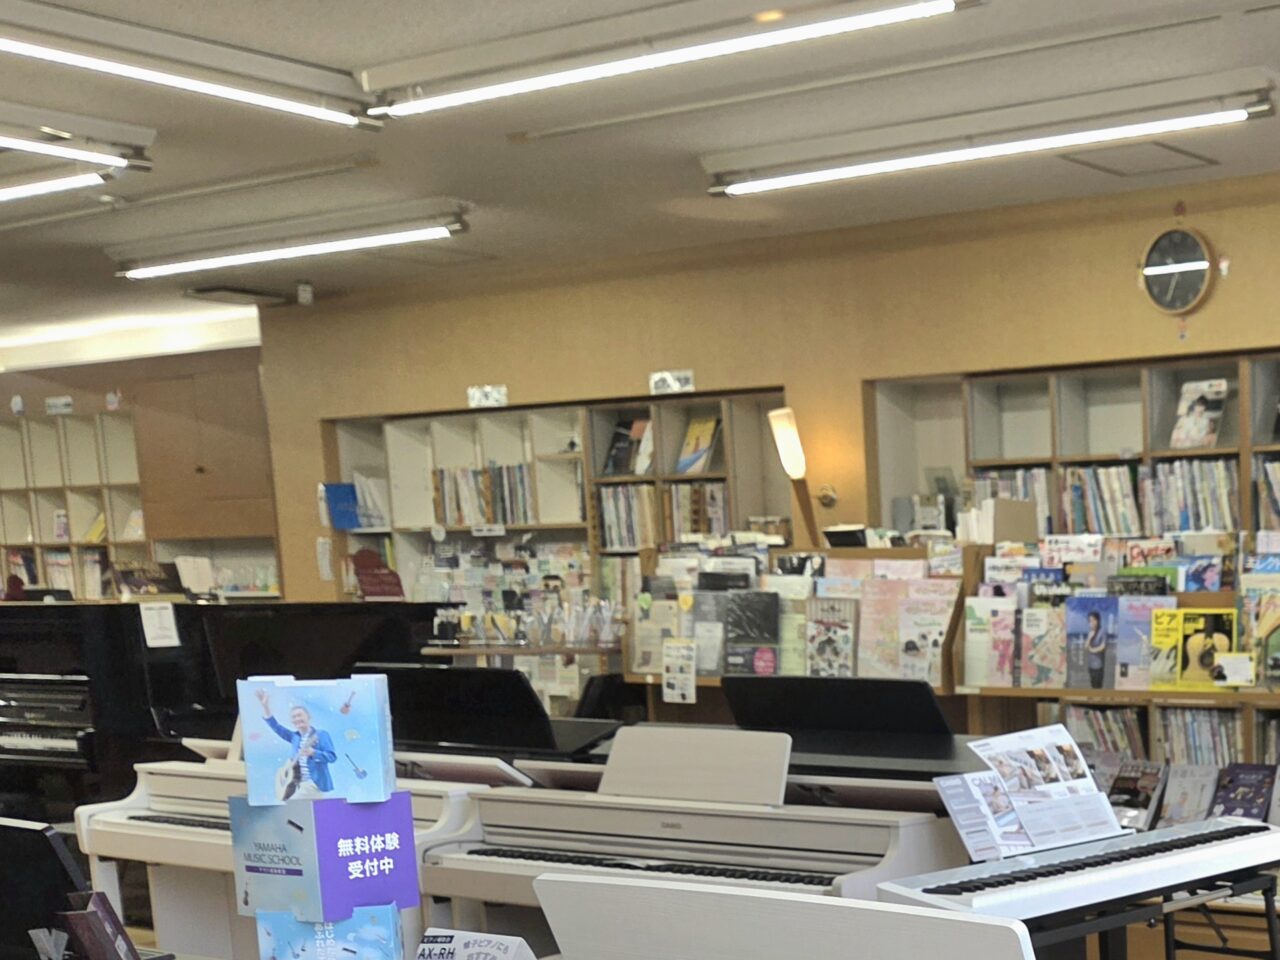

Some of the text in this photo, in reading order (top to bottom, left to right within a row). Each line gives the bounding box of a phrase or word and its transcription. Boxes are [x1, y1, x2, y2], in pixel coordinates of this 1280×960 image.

[337, 832, 400, 857] 無料体験
[347, 857, 394, 880] 受付中
[418, 947, 455, 960] AX-RH
